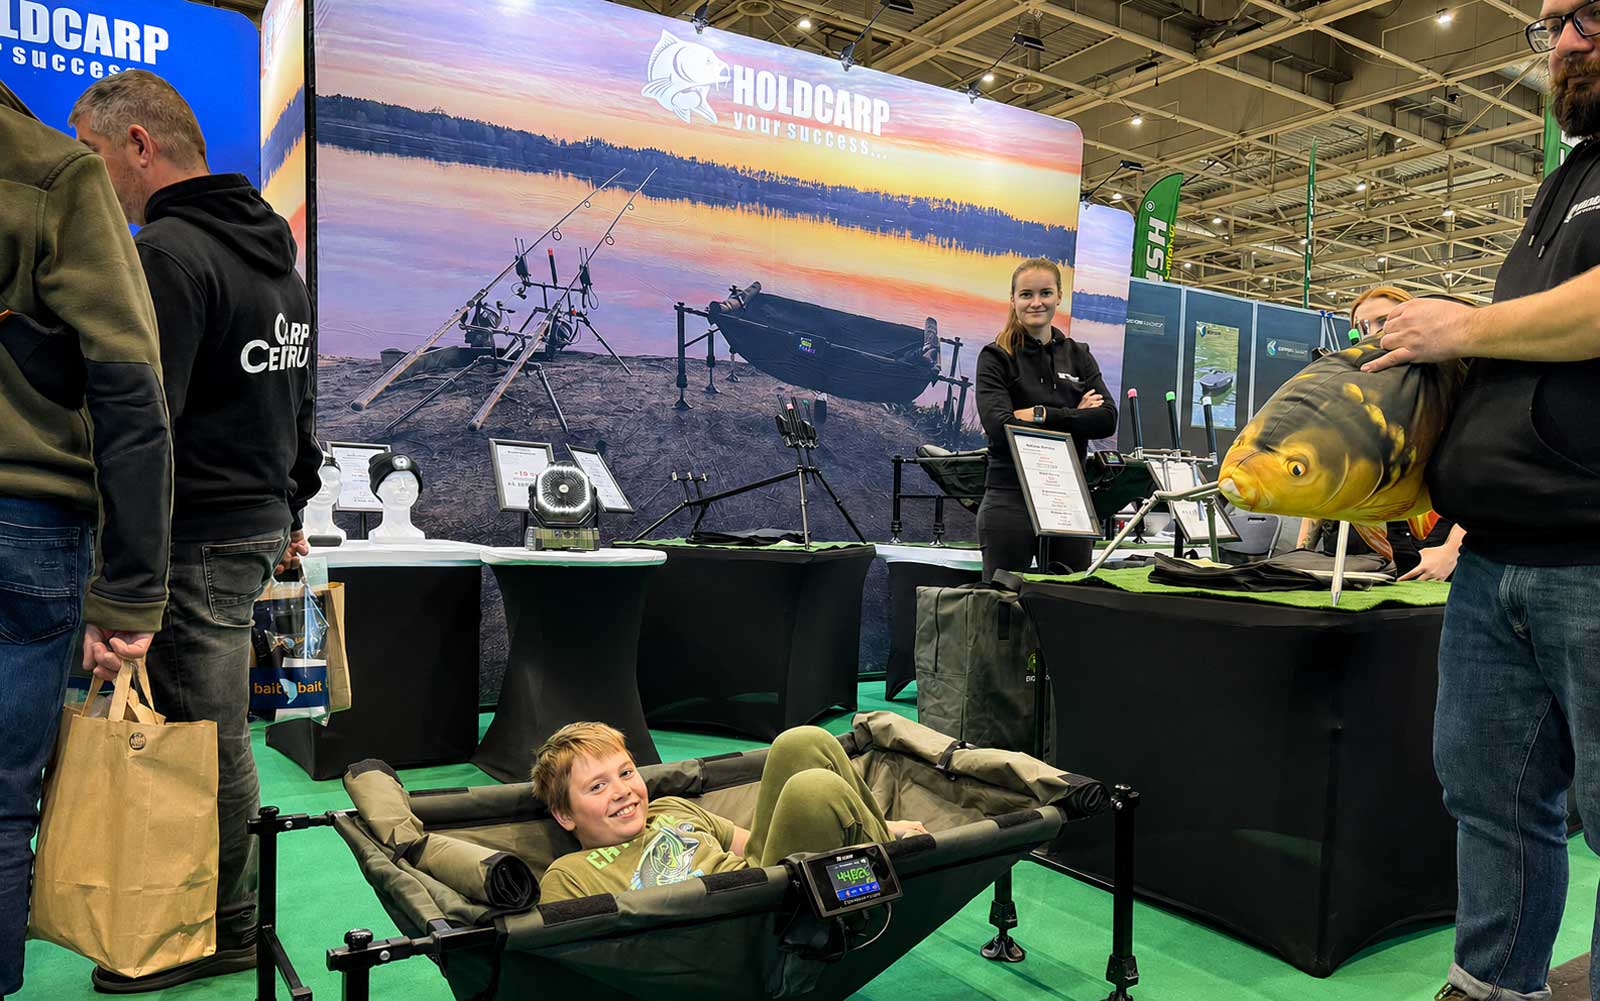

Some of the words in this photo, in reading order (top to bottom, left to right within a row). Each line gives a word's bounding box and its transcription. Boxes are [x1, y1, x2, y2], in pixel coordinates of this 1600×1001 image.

[12, 45, 137, 79] succes
[733, 64, 890, 136] HOLDCARP
[733, 112, 782, 137] your
[254, 681, 282, 695] bait
[297, 680, 323, 694] bait
